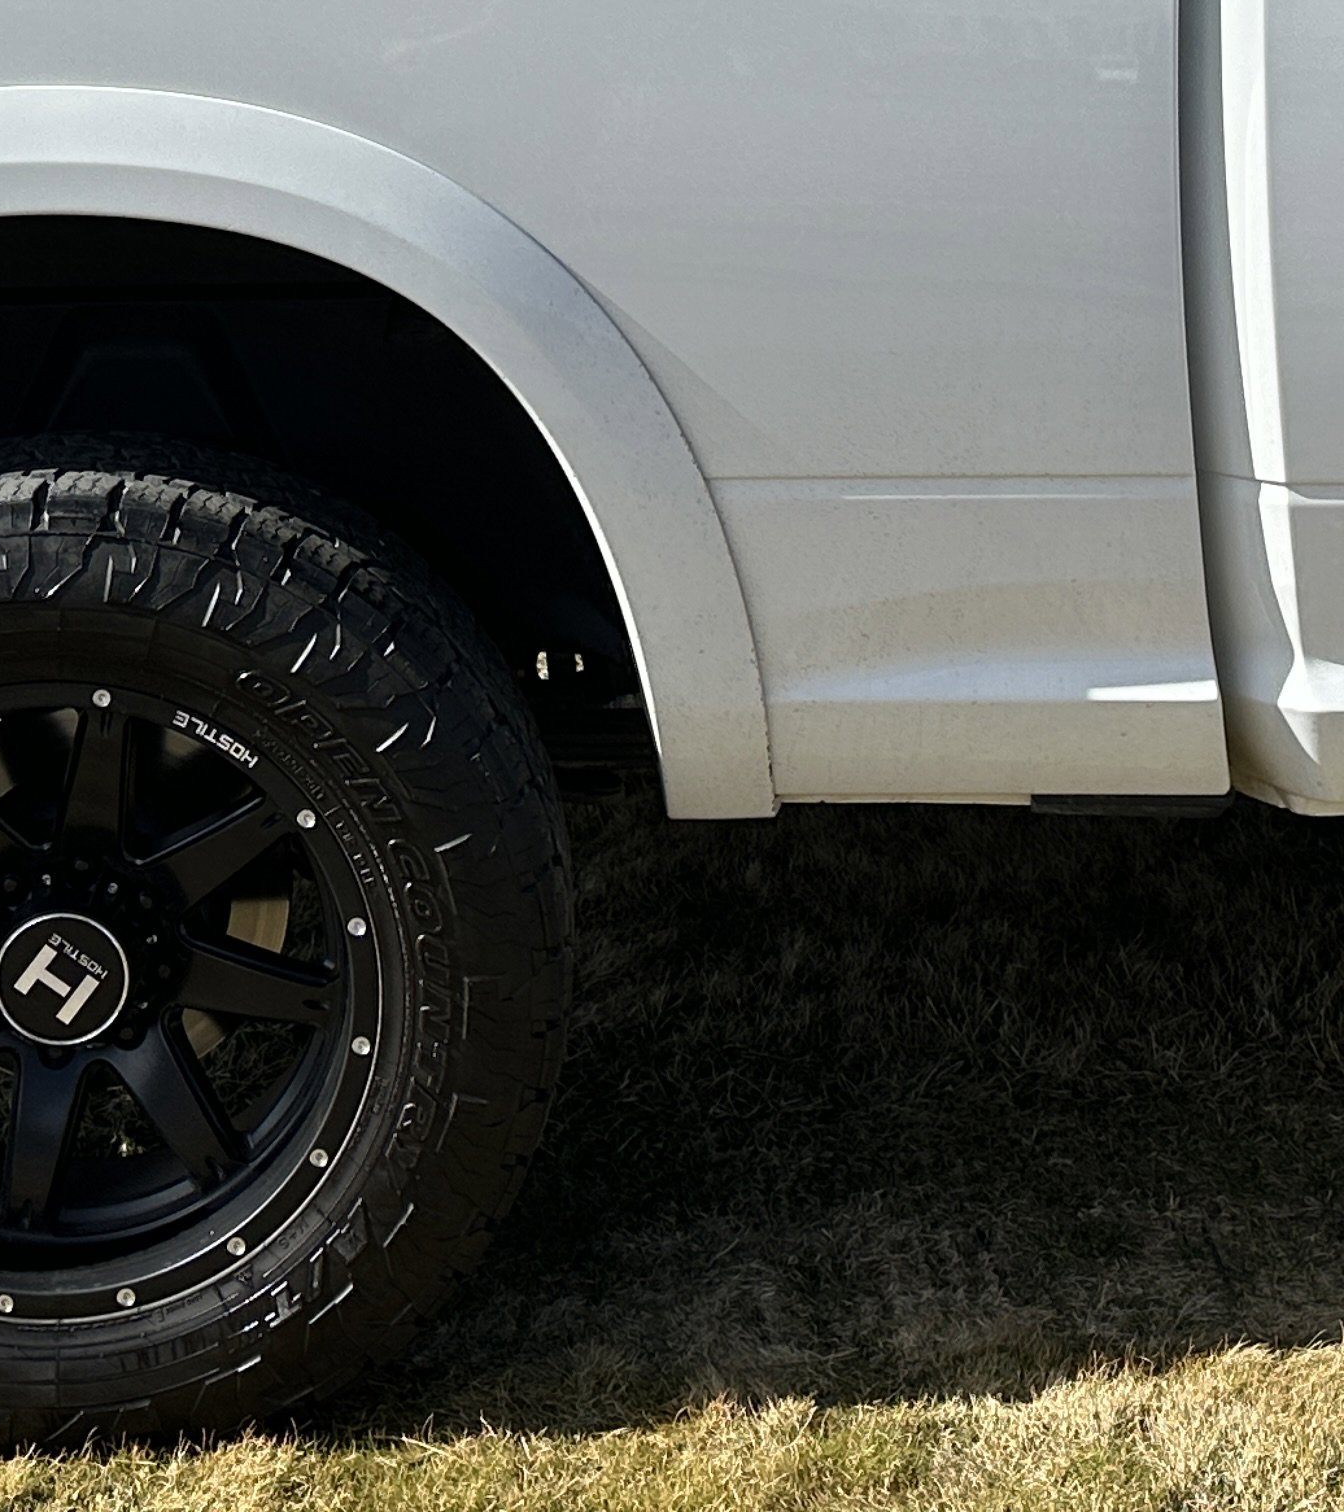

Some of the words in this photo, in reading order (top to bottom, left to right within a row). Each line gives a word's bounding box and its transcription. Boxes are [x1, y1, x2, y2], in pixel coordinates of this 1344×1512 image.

[172, 710, 258, 768] HOSTILE
[236, 670, 402, 822] OPEN
[47, 933, 108, 980] HOSTILE
